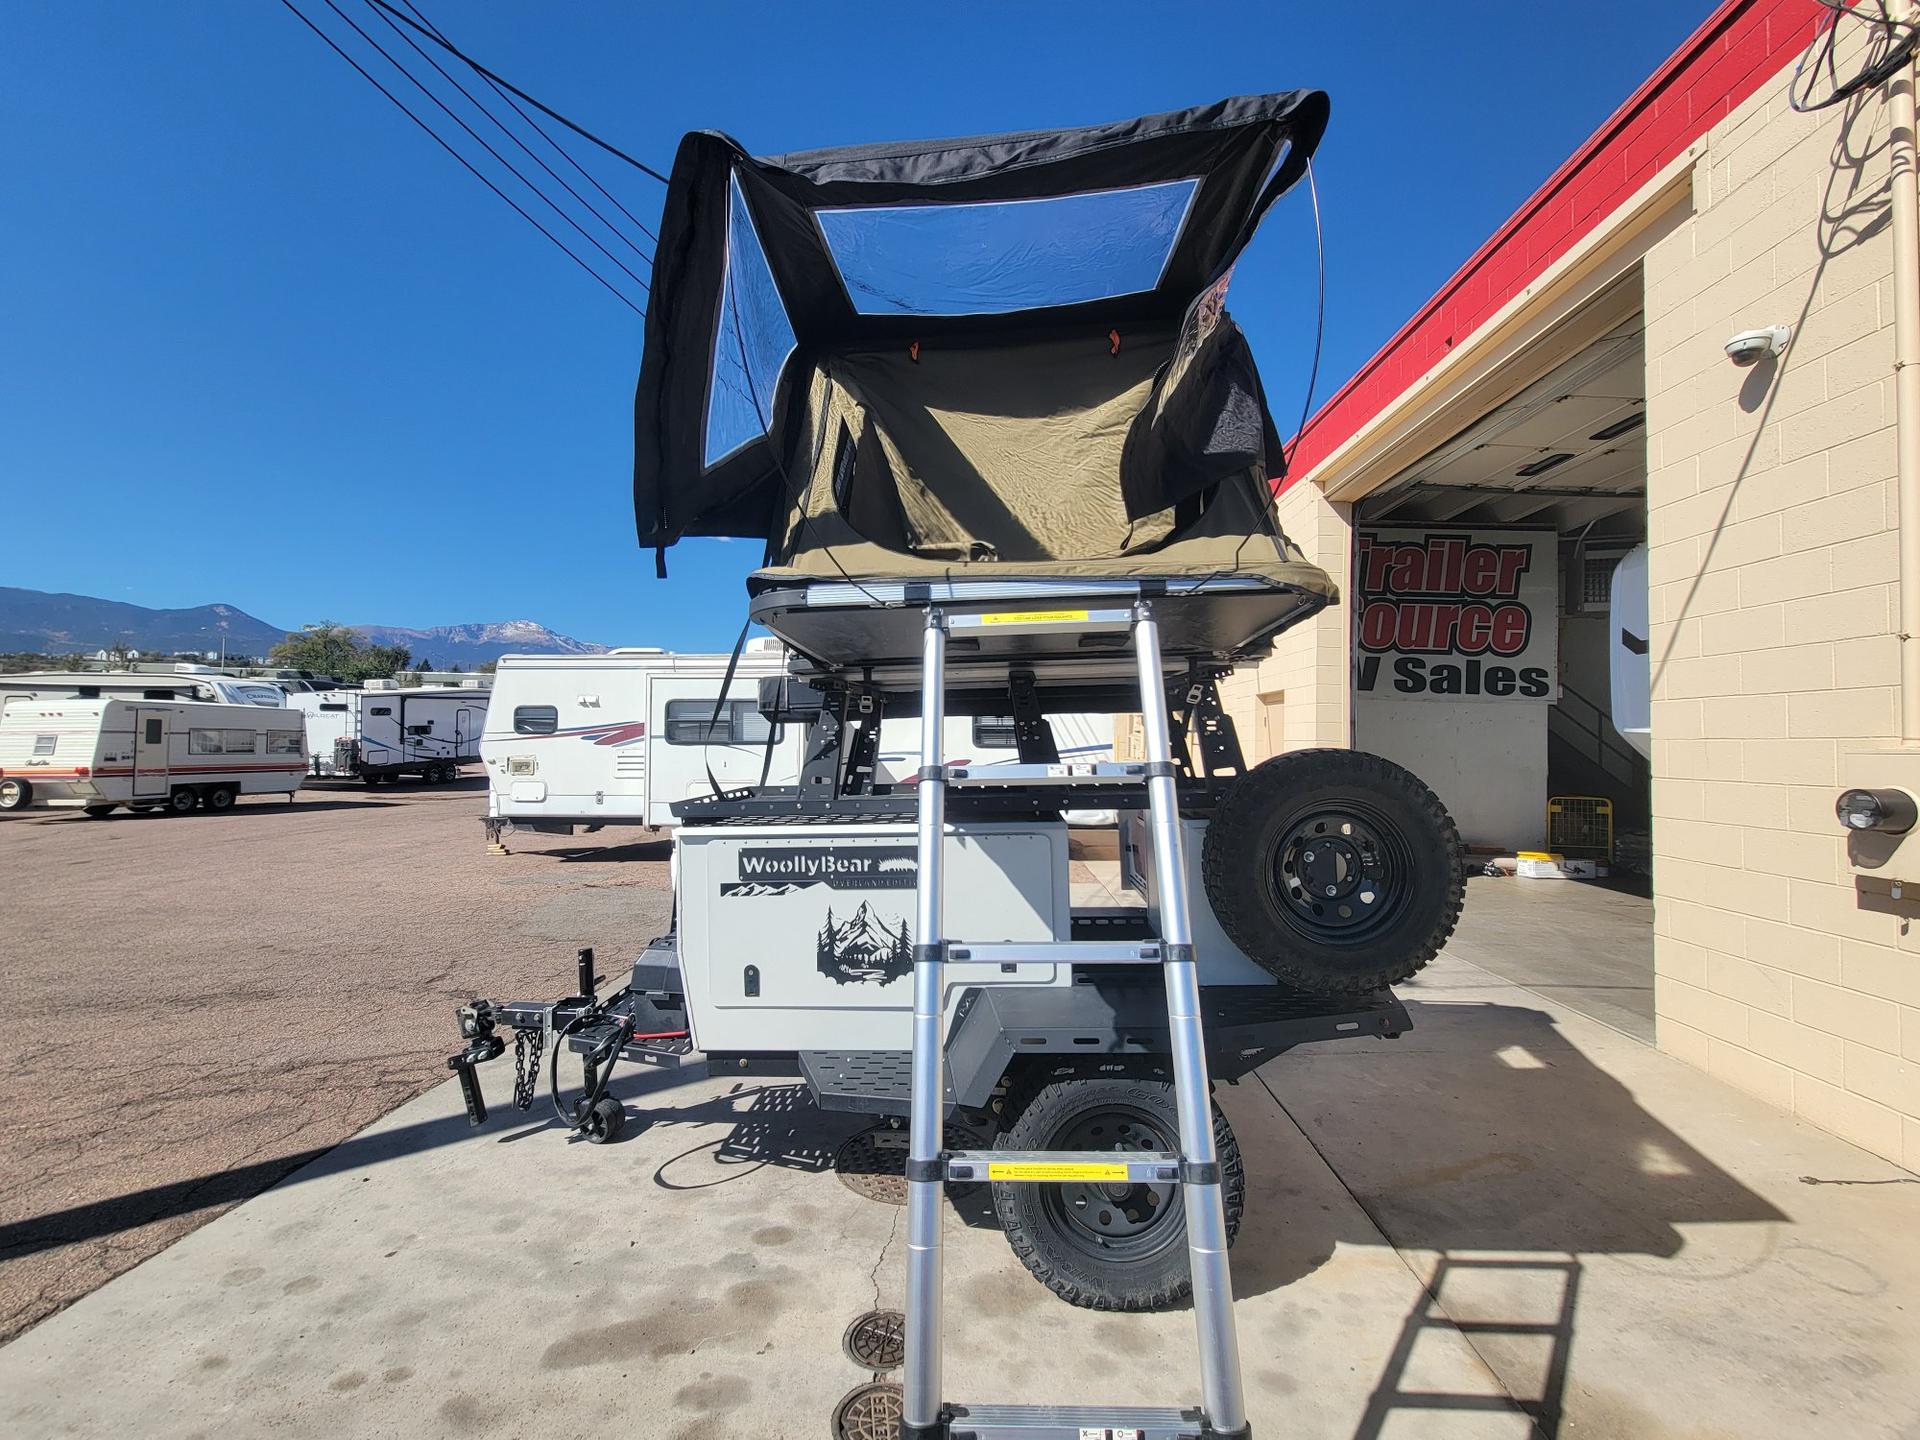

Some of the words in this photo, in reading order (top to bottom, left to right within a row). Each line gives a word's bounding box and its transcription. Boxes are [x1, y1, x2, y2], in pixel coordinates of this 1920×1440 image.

[1358, 599, 1532, 657] ource
[1394, 657, 1549, 697] Sales
[742, 855, 872, 876] WoollyBear
